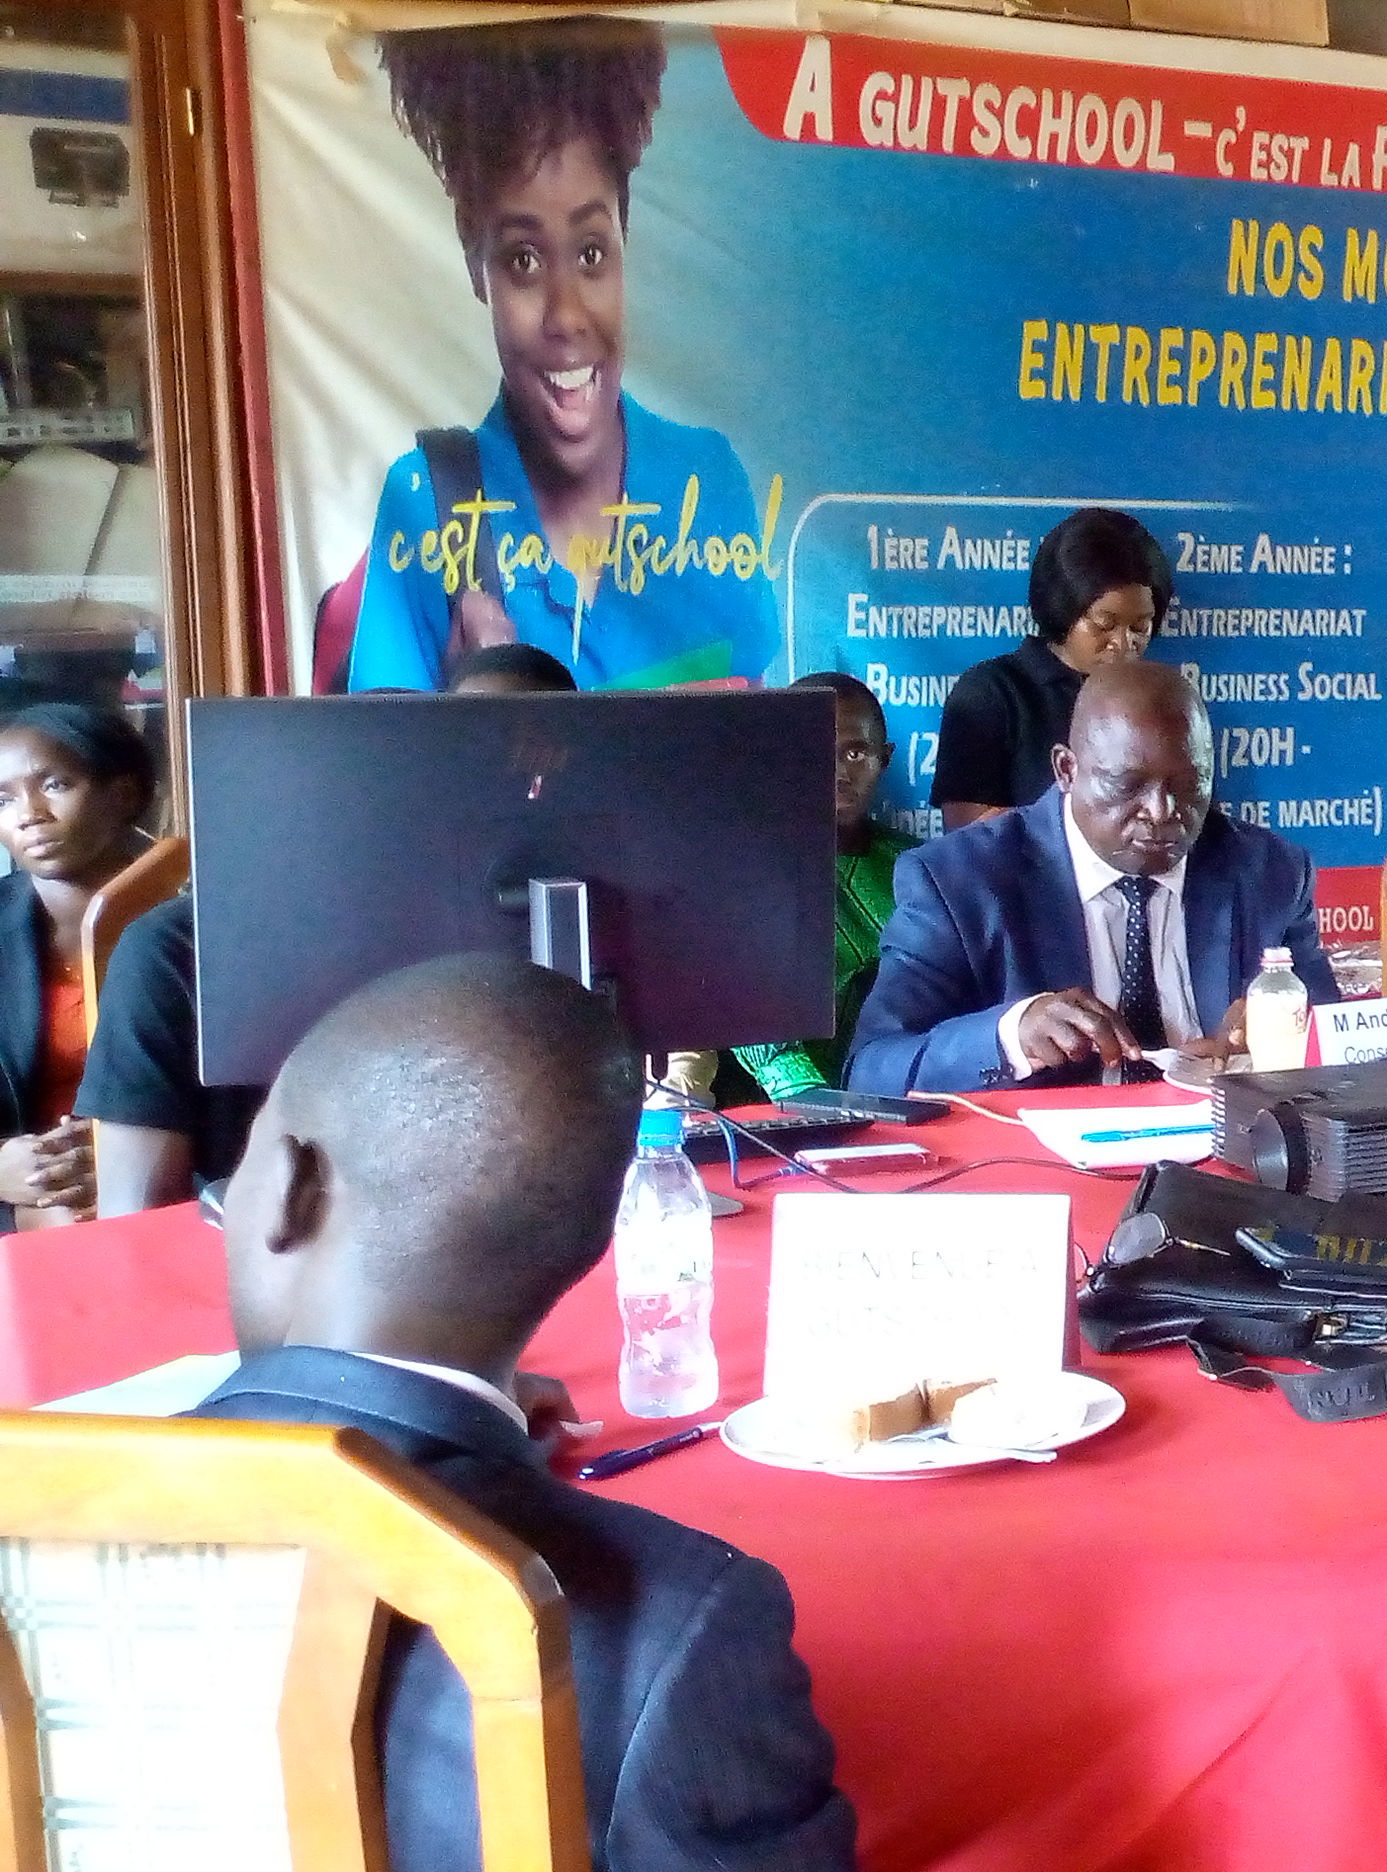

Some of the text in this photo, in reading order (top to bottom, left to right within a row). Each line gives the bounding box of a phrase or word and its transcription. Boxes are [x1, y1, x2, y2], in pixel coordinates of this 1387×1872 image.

[784, 37, 834, 143] A
[860, 70, 1174, 174] GUTSCHOOL
[1321, 139, 1360, 191] LA
[1227, 219, 1325, 300] NOS
[389, 472, 517, 596] c'est
[1180, 660, 1382, 703] BUSINESS SOCIAL
[1220, 727, 1295, 779] (20H
[1240, 801, 1271, 829] DE
[1317, 905, 1374, 933] HOOL
[1333, 1013, 1350, 1032] M
